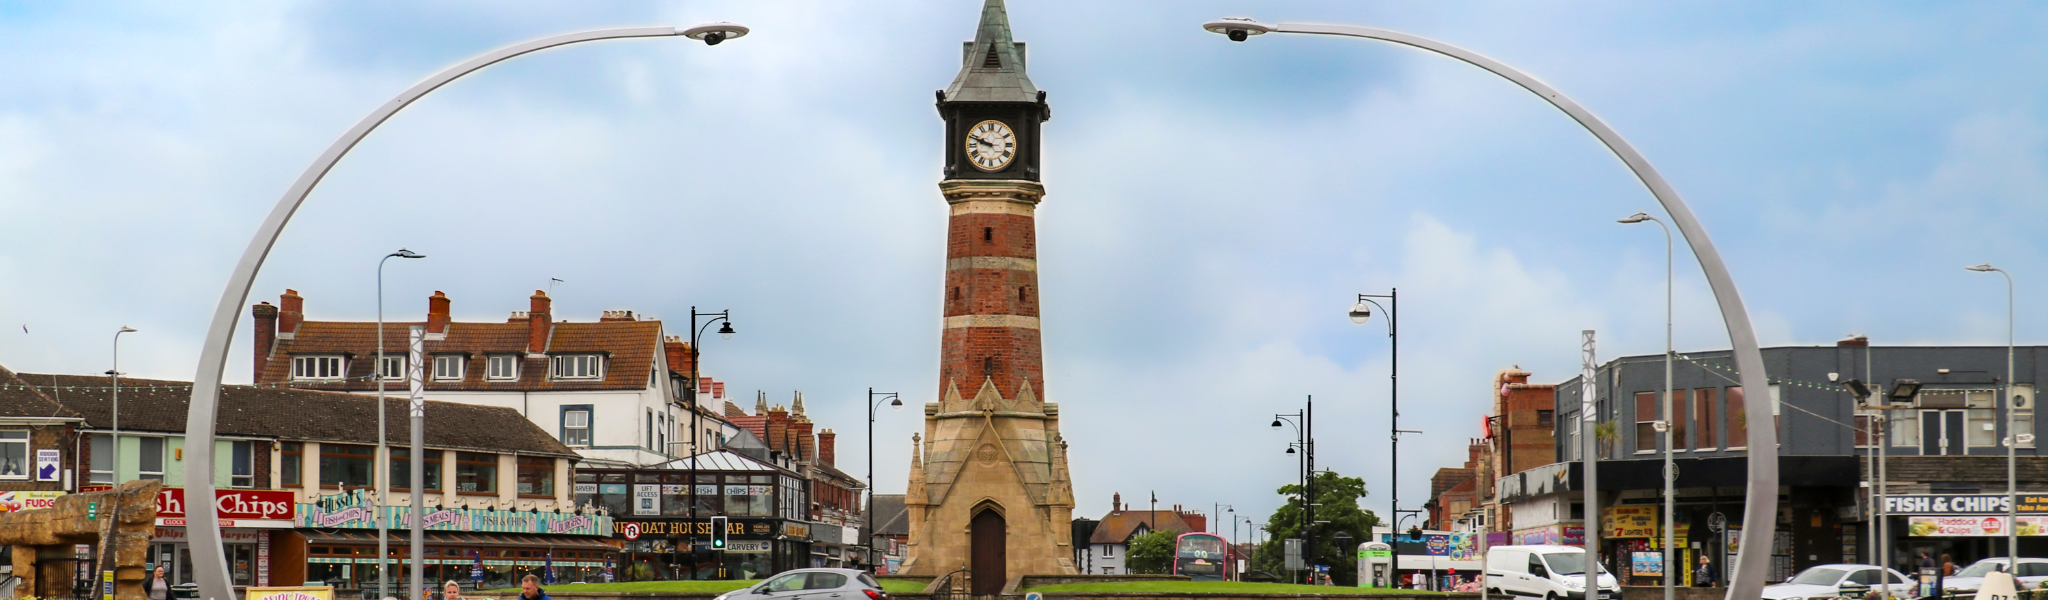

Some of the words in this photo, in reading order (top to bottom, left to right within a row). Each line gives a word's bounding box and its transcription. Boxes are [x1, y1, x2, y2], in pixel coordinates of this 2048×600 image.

[726, 487, 747, 495] CHIPS
[216, 493, 288, 519] Chips
[1885, 497, 1930, 512] FISH
[1932, 497, 1949, 512] &
[1950, 496, 2011, 512] CHIPS
[325, 517, 338, 525] FISH
[342, 509, 360, 520] CHIPS
[429, 511, 449, 523] MEALS
[482, 515, 498, 526] FISH
[500, 516, 505, 526] &
[507, 516, 528, 527] CHIPS
[1938, 518, 1977, 526] Haddock
[558, 516, 582, 532] BURGERS
[727, 522, 745, 535] AR
[1946, 526, 1972, 535] Chips
[726, 543, 760, 551] CARVERY
